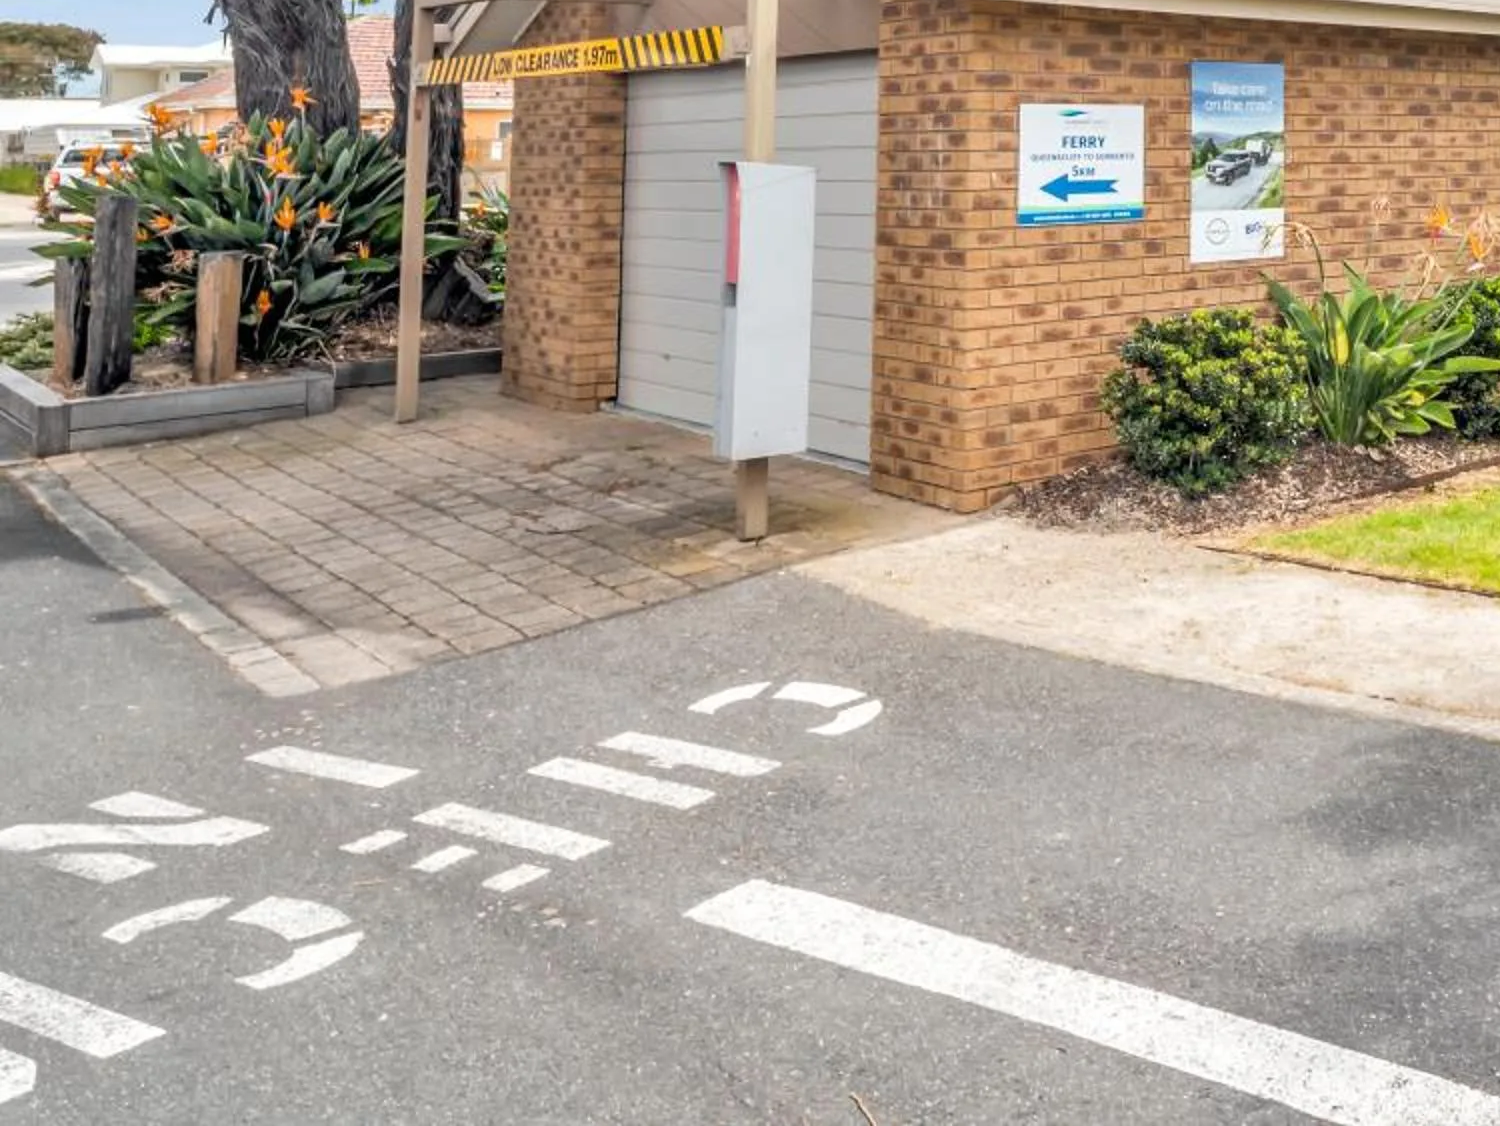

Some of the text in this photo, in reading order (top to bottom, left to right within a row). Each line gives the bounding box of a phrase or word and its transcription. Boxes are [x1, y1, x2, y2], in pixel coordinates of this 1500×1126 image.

[516, 48, 579, 72] CLEARANCE
[584, 45, 618, 67] 1.97m
[1061, 135, 1105, 149] FERRY
